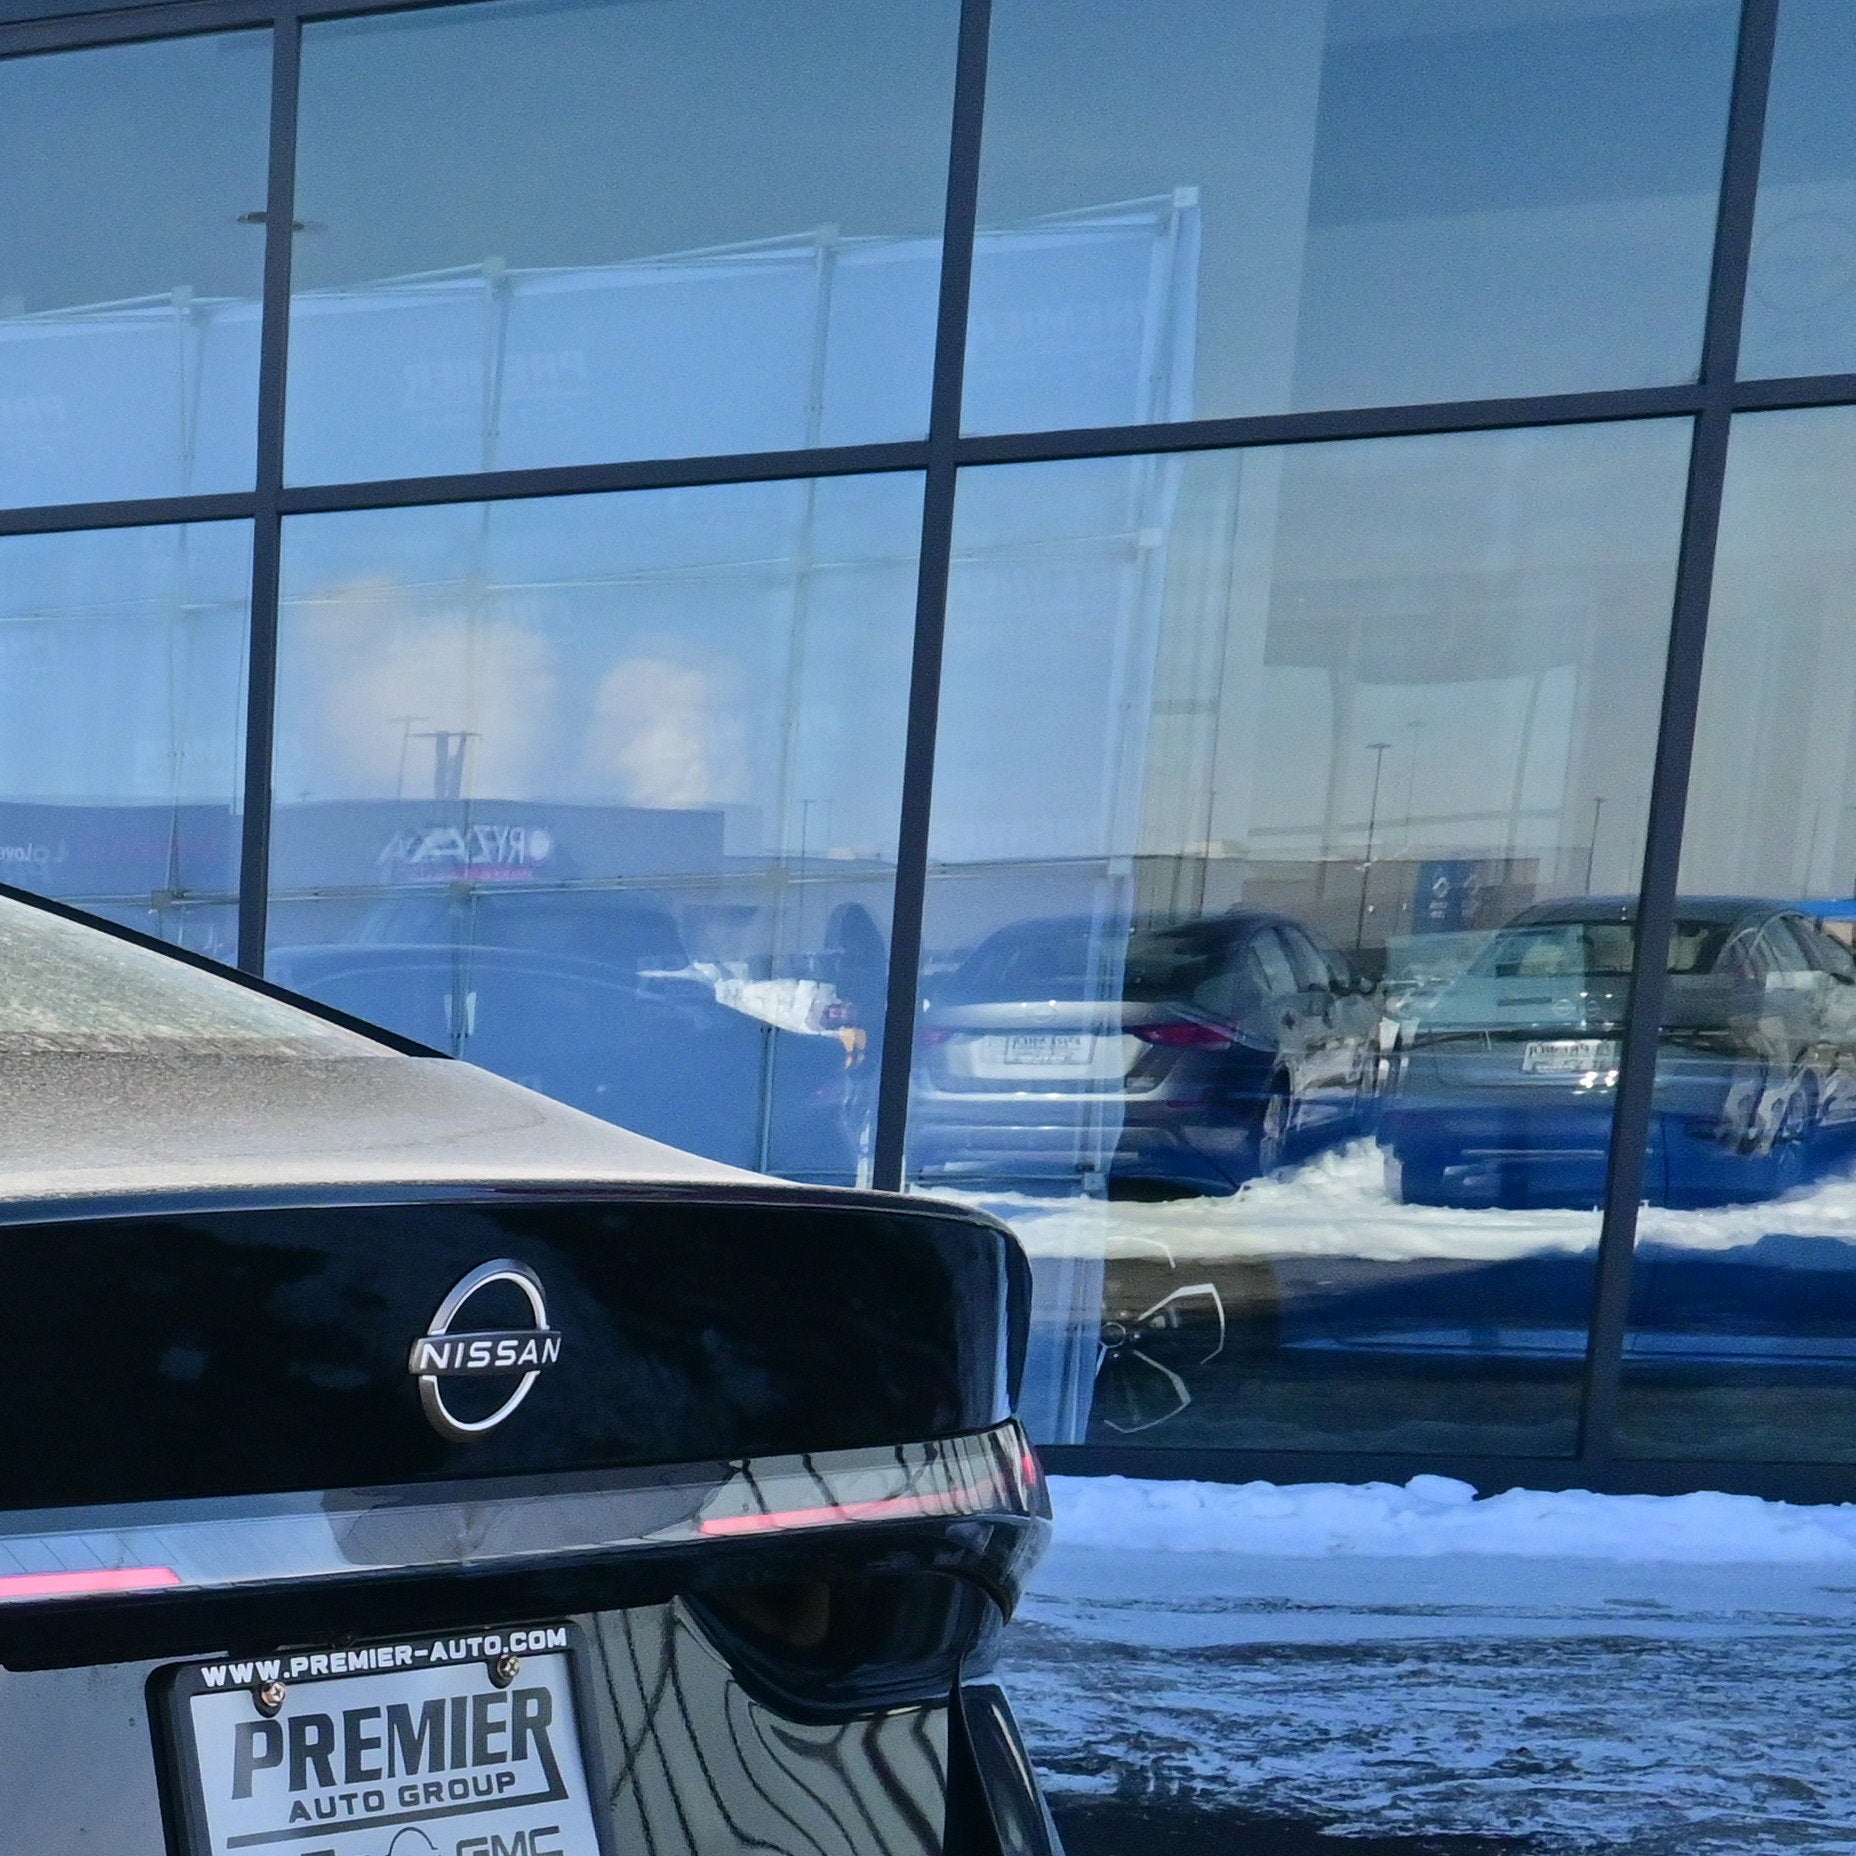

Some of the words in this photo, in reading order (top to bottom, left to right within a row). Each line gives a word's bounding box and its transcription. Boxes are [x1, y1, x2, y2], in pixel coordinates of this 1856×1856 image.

[419, 1337, 562, 1370] NISSAN
[201, 1627, 567, 1687] WWW.PREMIER-AUTO.COM
[231, 1686, 569, 1800] PREMIER
[288, 1788, 385, 1824] AUTO
[397, 1771, 517, 1808] GROUP
